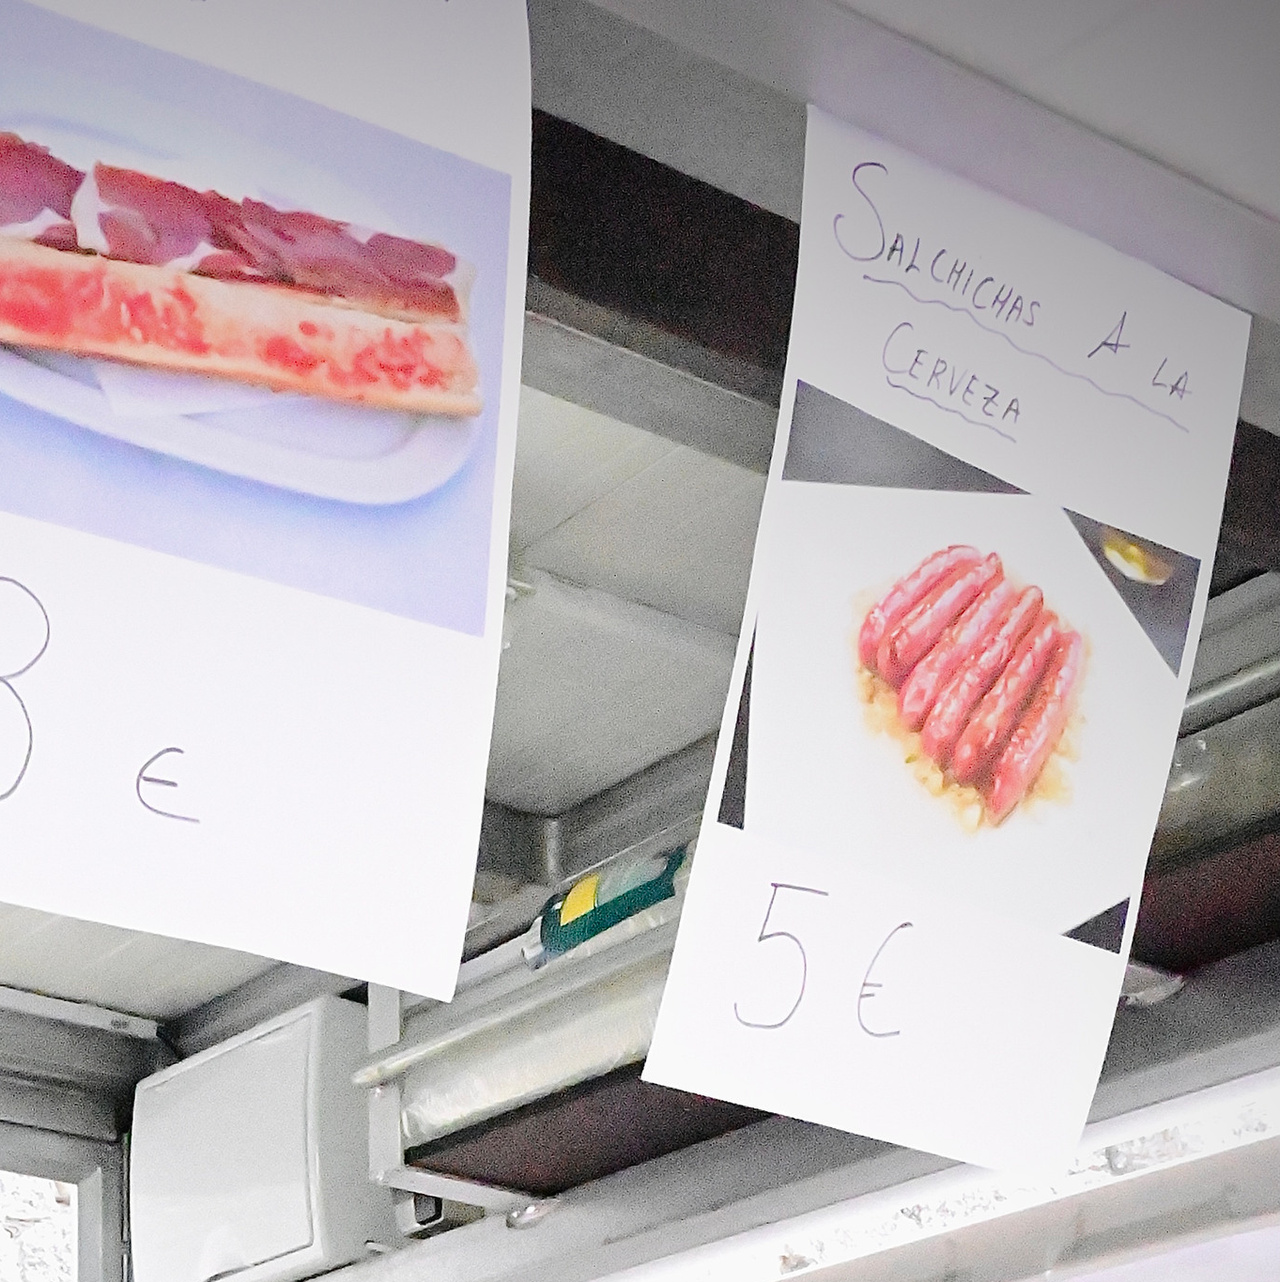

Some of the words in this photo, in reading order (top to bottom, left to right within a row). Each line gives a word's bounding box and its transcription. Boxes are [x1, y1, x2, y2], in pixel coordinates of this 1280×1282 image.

[833, 160, 1044, 328] SALCHICHAS
[1087, 310, 1132, 360] A
[1151, 357, 1194, 400] LA
[882, 321, 1022, 425] CERVEZA
[134, 746, 201, 825] €
